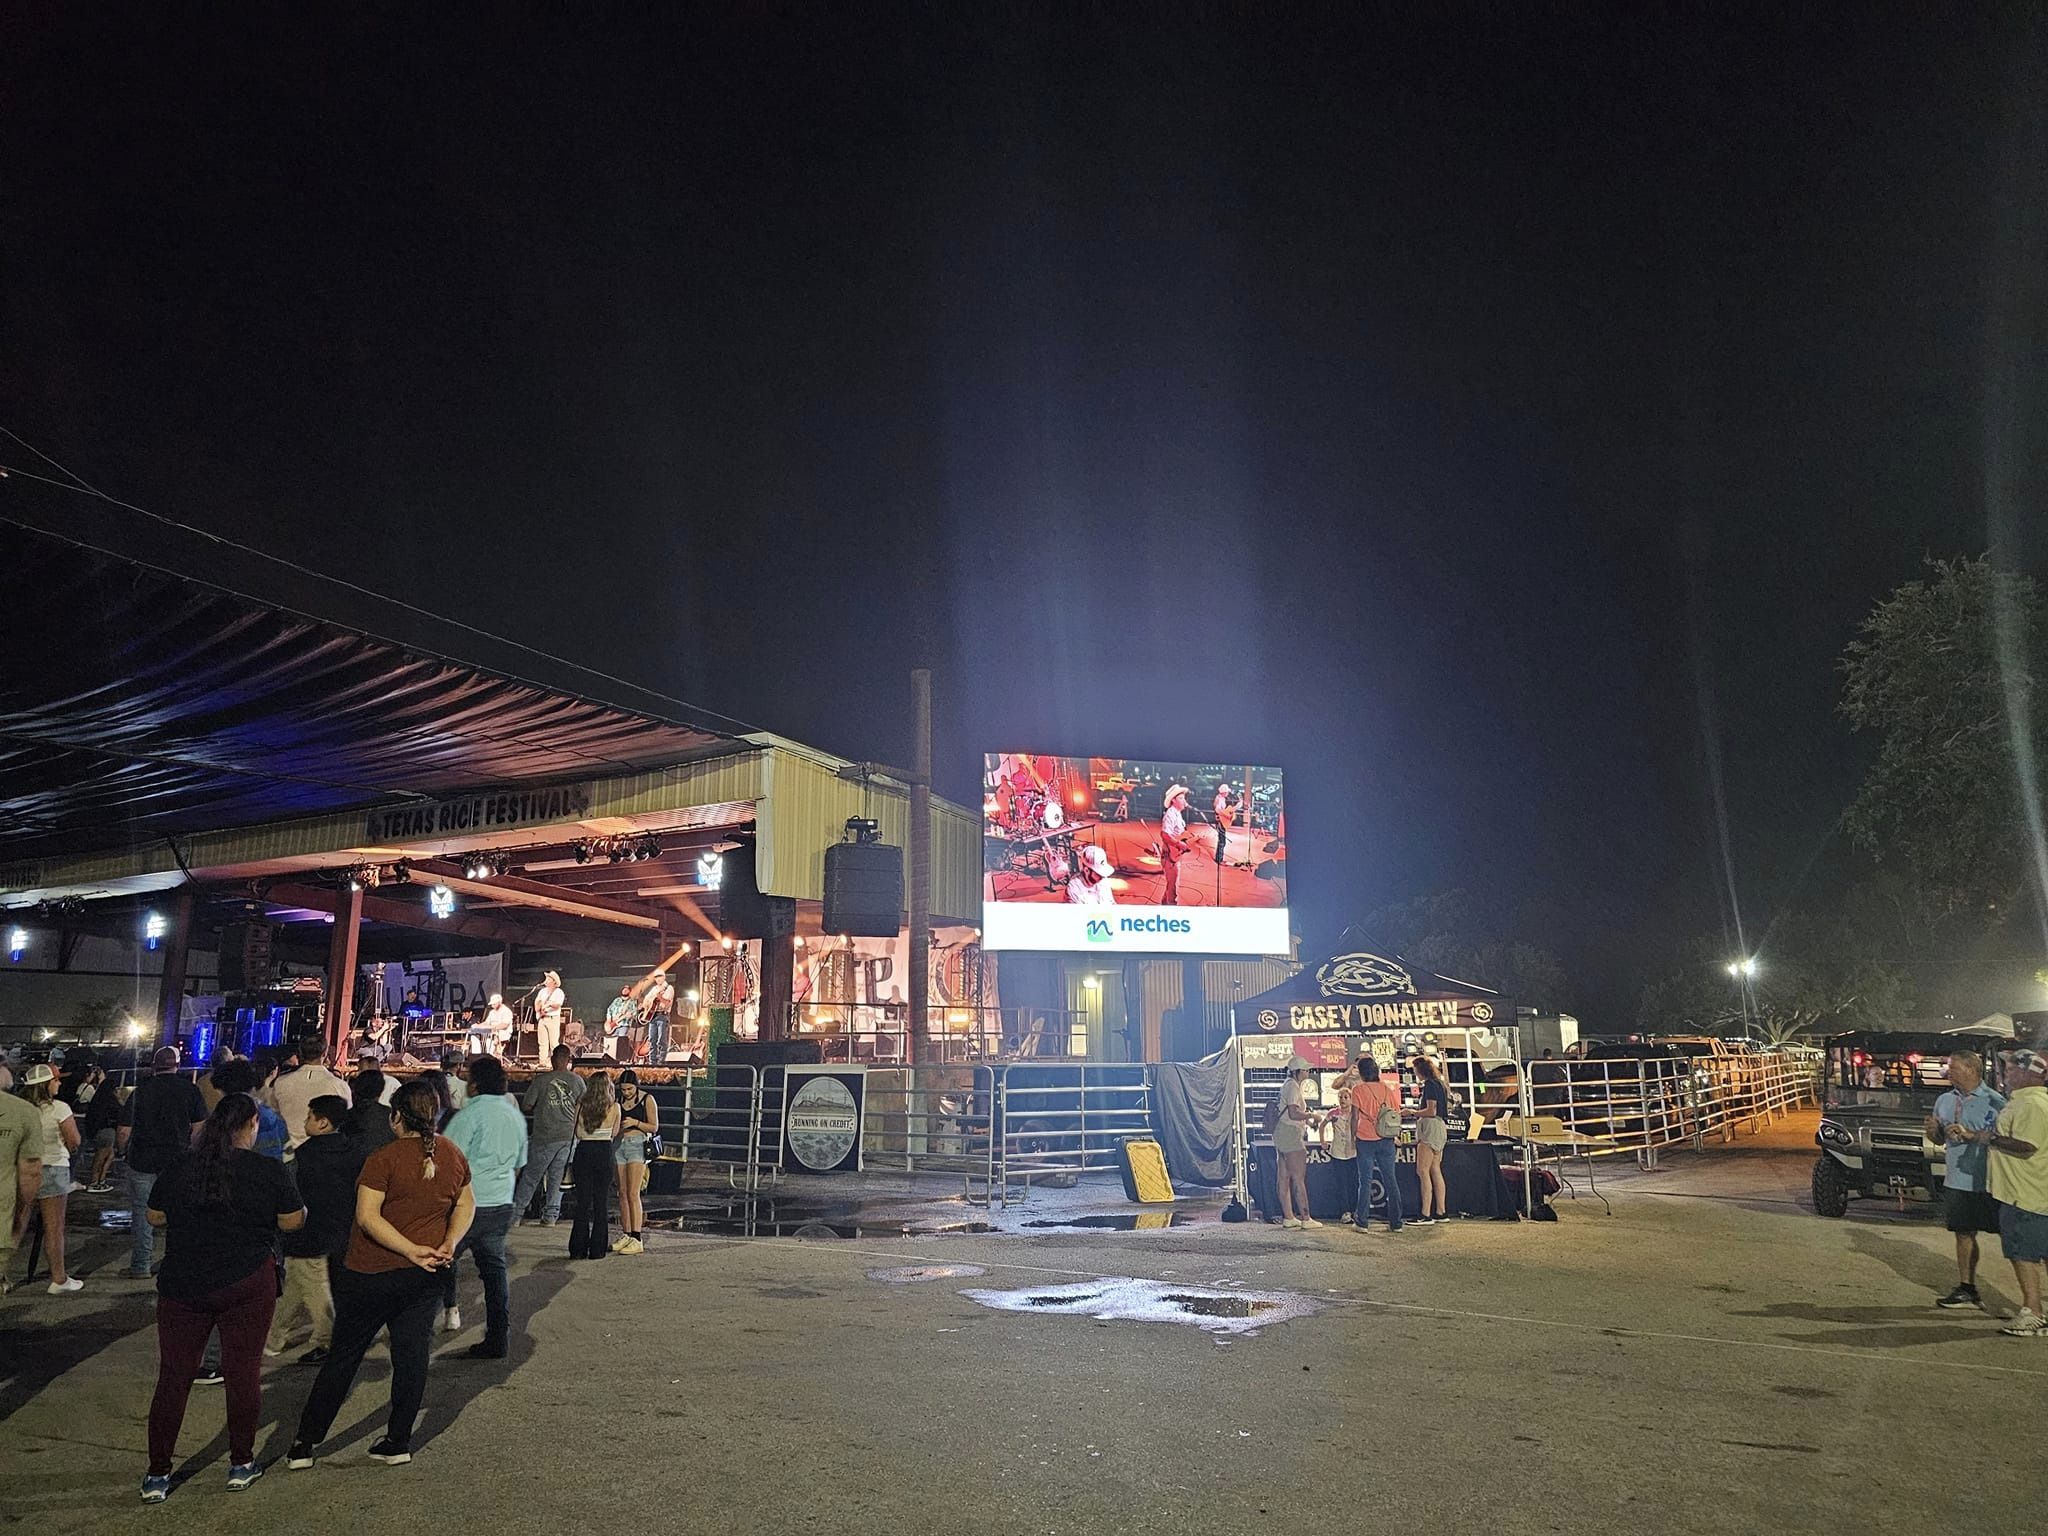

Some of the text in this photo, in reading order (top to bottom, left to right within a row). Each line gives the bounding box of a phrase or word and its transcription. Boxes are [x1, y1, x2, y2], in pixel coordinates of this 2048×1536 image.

[383, 789, 571, 838] TEXAS RICE FESTIVAL
[1120, 914, 1191, 932] neches
[1290, 1001, 1458, 1030] CASEY DONAHEW
[793, 1118, 818, 1128] RUNNING
[820, 1119, 828, 1128] ON
